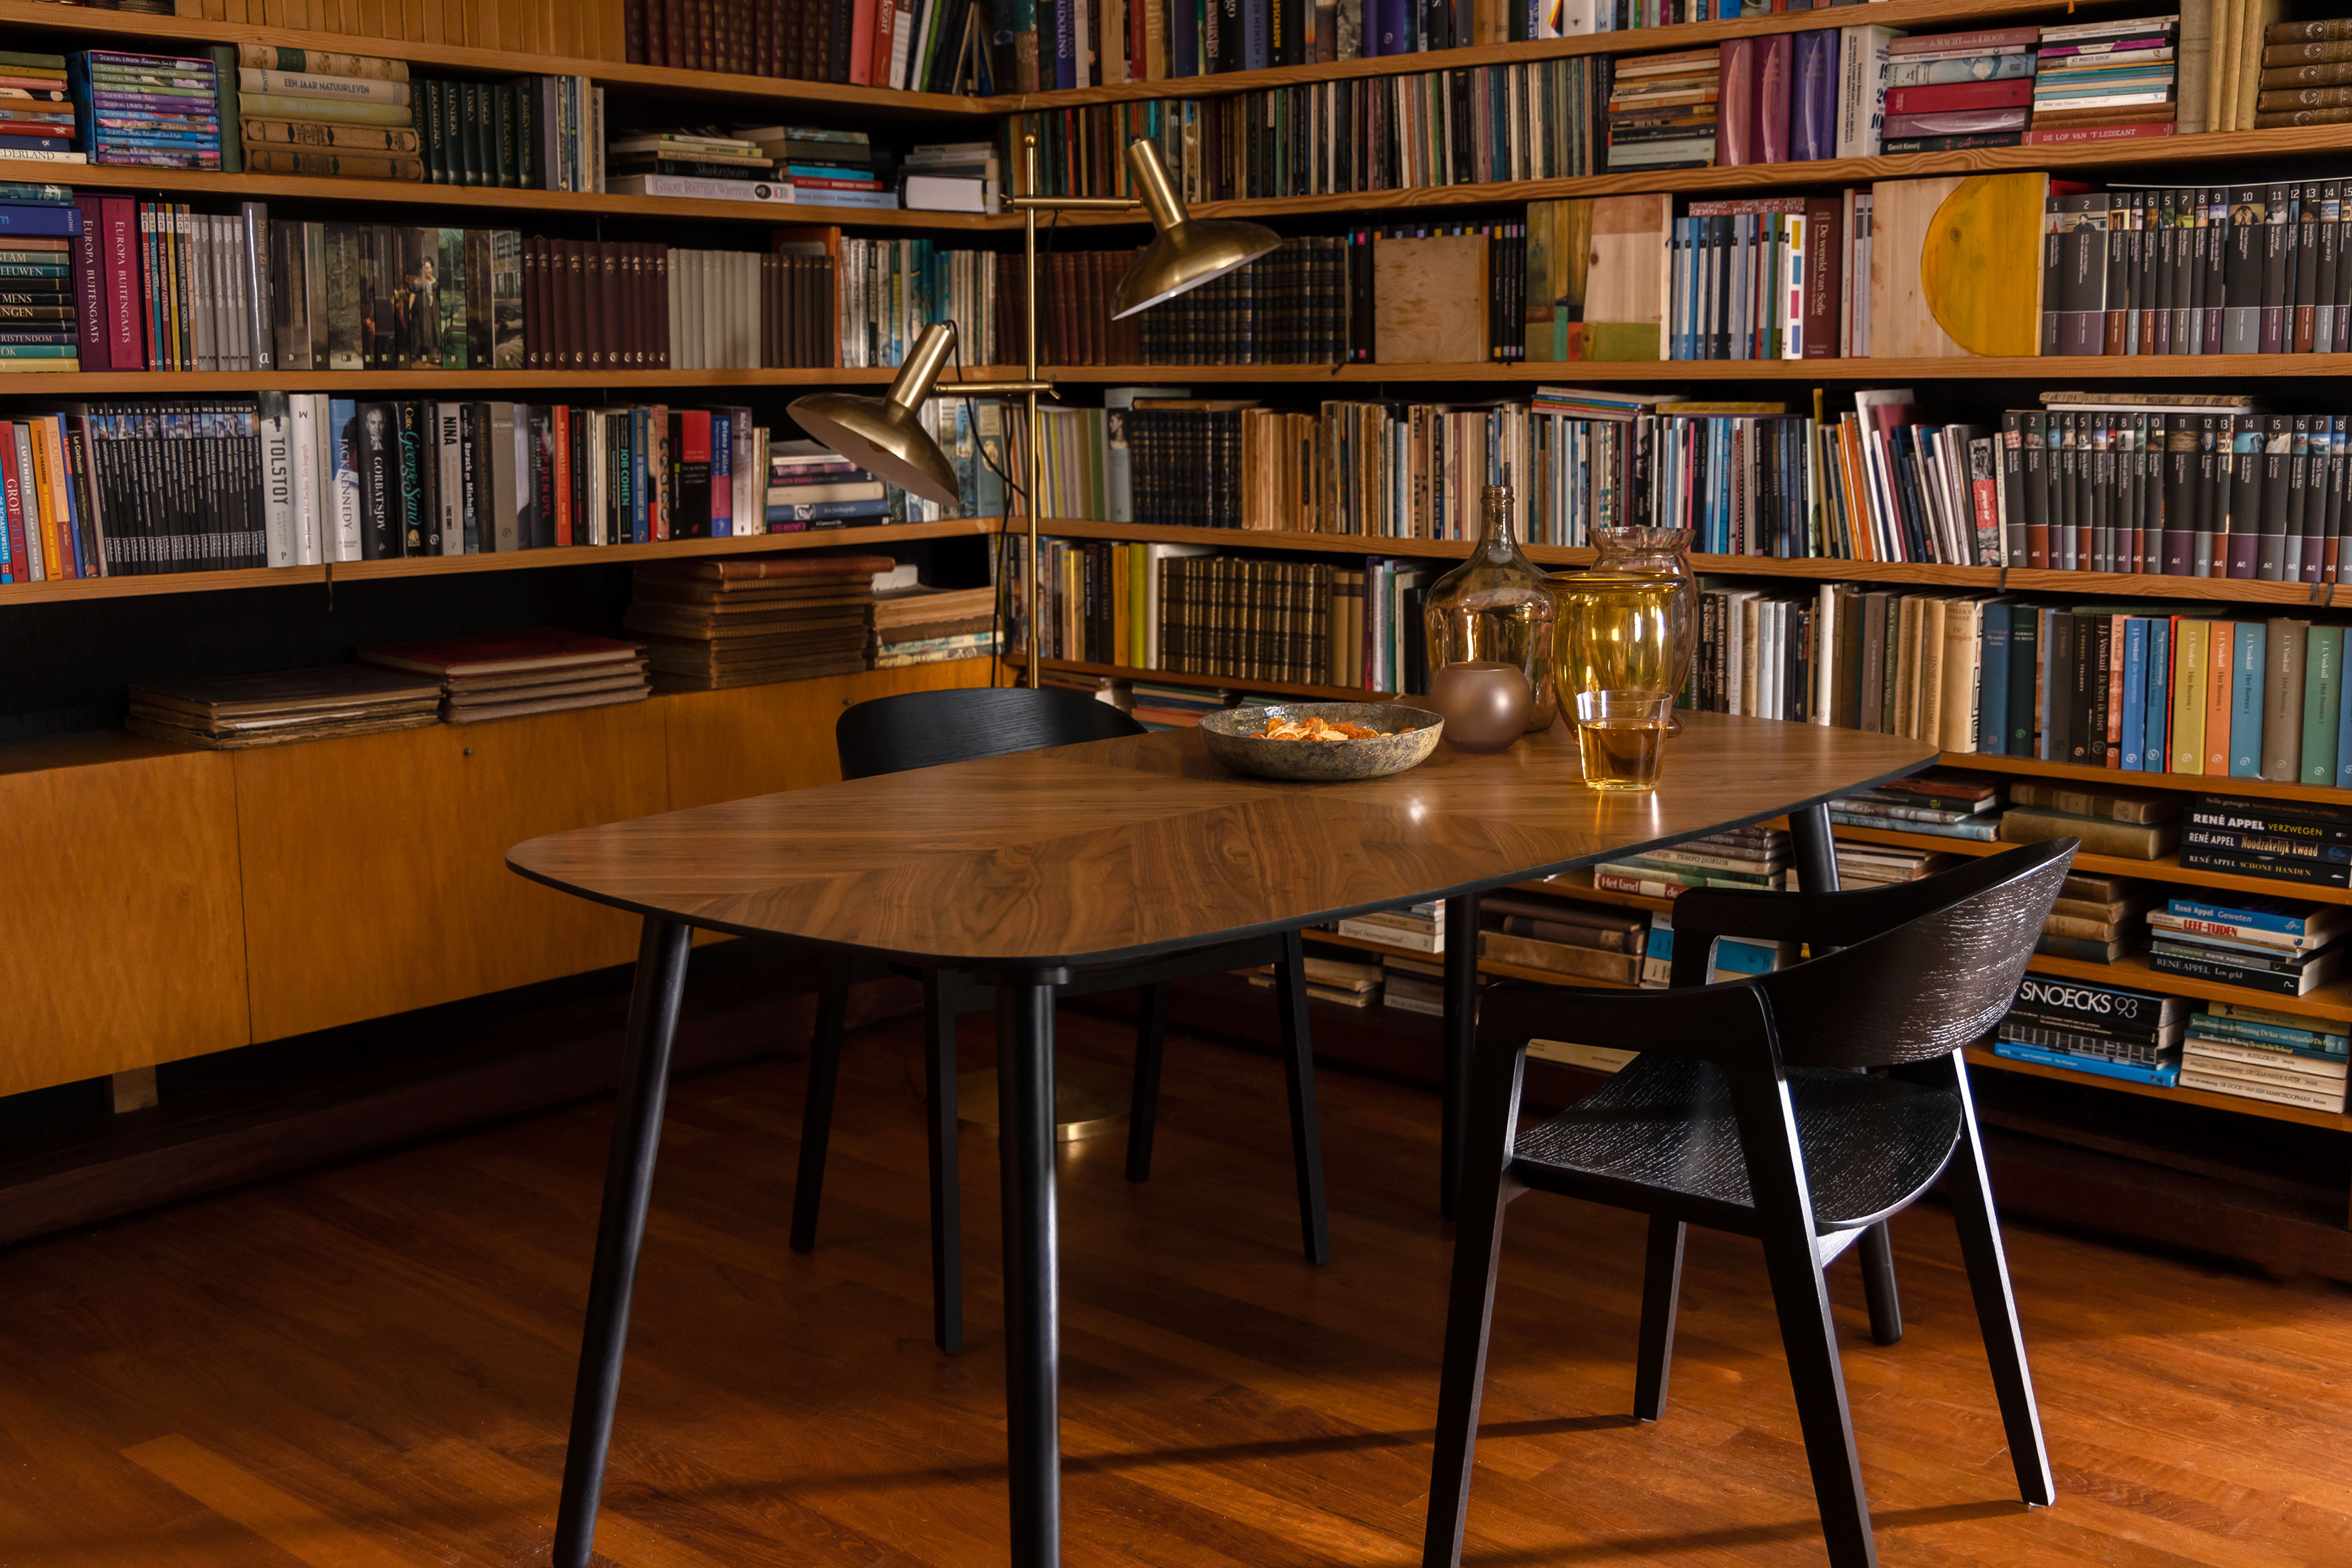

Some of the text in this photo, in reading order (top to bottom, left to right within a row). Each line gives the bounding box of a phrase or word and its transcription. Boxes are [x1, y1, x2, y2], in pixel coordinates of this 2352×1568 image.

[285, 79, 369, 95] EEN JAAR NATUURLEVEN
[448, 88, 457, 136] VLINDERS
[2099, 129, 2136, 137] LEDIKANT
[2116, 198, 2122, 207] 3
[2148, 197, 2154, 207] 6
[2199, 194, 2205, 203] 8
[2242, 192, 2252, 202] 10
[2305, 189, 2316, 198] 13
[2325, 188, 2335, 198] 14
[2083, 200, 2089, 209] 2
[258, 219, 267, 265] Zhuang Zi
[1820, 224, 1829, 238] De
[1818, 240, 1828, 271] wereld
[83, 220, 99, 343] EUROPA BUITENGAATS
[116, 221, 130, 343] EUROPA BUITENGAATS
[3, 294, 32, 304] MENS
[1817, 294, 1826, 316] Sofie
[443, 416, 457, 445] NINA
[2030, 417, 2036, 426] 2
[2151, 418, 2160, 428] 10
[2272, 420, 2281, 429] 15
[2335, 420, 2344, 430] 18
[49, 430, 63, 487] BLOOTGEVEN
[73, 436, 83, 474] Le Corbusier
[21, 446, 31, 495] LUYENDIJK
[270, 437, 288, 505] TOLSTOY
[400, 431, 422, 526] George Sand
[464, 442, 474, 517] Barack Michelle
[621, 448, 629, 506] JOB COHEN
[338, 438, 352, 530] JACK KENNEDY
[373, 456, 385, 531] GORBATSJOV
[541, 466, 550, 518] DEN UYL
[7, 478, 24, 553] GROF GELD
[2099, 639, 2108, 671] Voskuil
[2321, 653, 2329, 678] Voskuil
[2098, 674, 2106, 684] Ik
[2132, 664, 2138, 673] De
[2098, 686, 2106, 701] ben
[2223, 800, 2249, 808] getuigen
[2193, 813, 2323, 836] RENÉ APPEL VERZWEGEN
[2189, 831, 2319, 857] RENÉ APPEL Noodzakelijk kwaad
[2189, 853, 2312, 876] RENÉ APPEL SCHONE HANDEN
[1601, 875, 1679, 897] Het land de
[2174, 903, 2252, 923] René Appel Geweten
[2156, 958, 2243, 979] RENÉ APPEL Los geld
[2020, 981, 2138, 1019] SNOECKS 93
[2266, 1089, 2312, 1102] MARKTKOOPMAN
